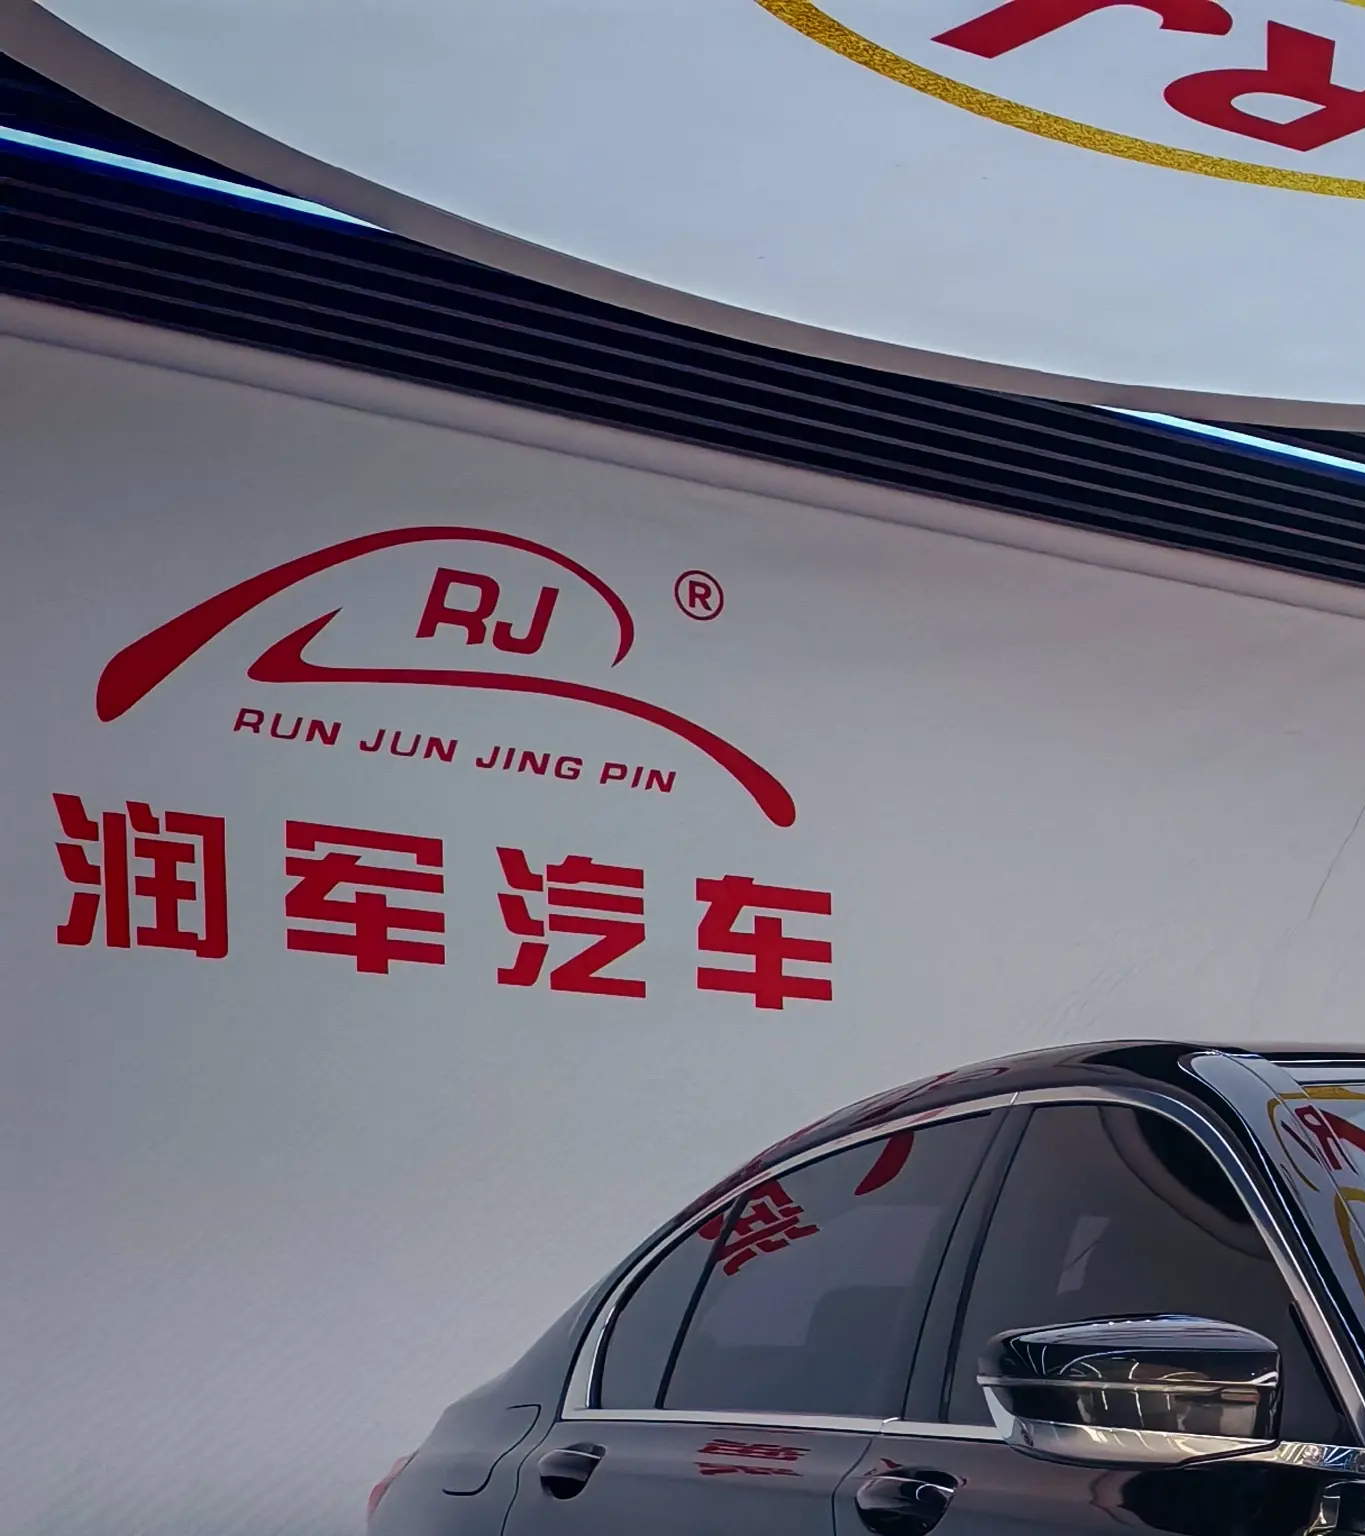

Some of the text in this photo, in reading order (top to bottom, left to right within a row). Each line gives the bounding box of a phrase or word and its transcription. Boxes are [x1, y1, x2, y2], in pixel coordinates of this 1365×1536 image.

[416, 567, 559, 655] RJ
[234, 707, 677, 793] RUN JUN JING PIN
[53, 792, 833, 1010] 润军汽车
